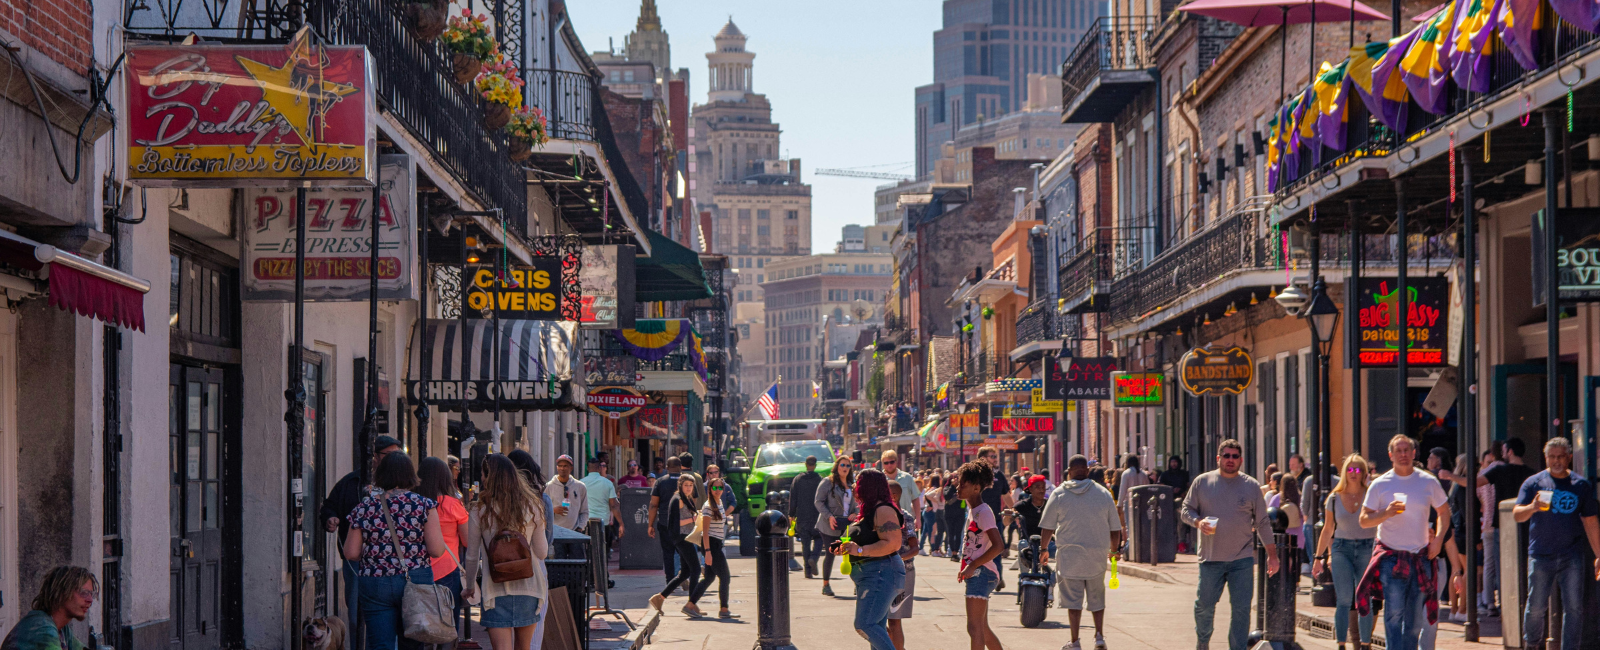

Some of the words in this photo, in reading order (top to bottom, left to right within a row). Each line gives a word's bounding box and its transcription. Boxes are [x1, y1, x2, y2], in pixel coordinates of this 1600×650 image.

[148, 53, 230, 106] Big
[135, 101, 291, 154] Daddy's
[137, 150, 269, 174] Bottomless
[272, 150, 364, 177] Topless
[254, 194, 400, 233] PIZZA
[279, 237, 372, 253] EPRESS
[259, 259, 296, 277] PIZZA
[328, 259, 353, 276] THE
[357, 259, 396, 277] SLCE
[468, 291, 557, 312] OWENS
[1359, 302, 1390, 327] BIG
[1396, 302, 1441, 327] ASY
[1052, 372, 1111, 381] SUTR
[1187, 364, 1250, 380] BANDSTAND
[413, 381, 478, 401] CHRIS
[486, 381, 563, 400] OWENS
[587, 395, 646, 407] DIXIELAND
[1018, 418, 1038, 432] LEGAL
[1038, 418, 1054, 432] CLUB
